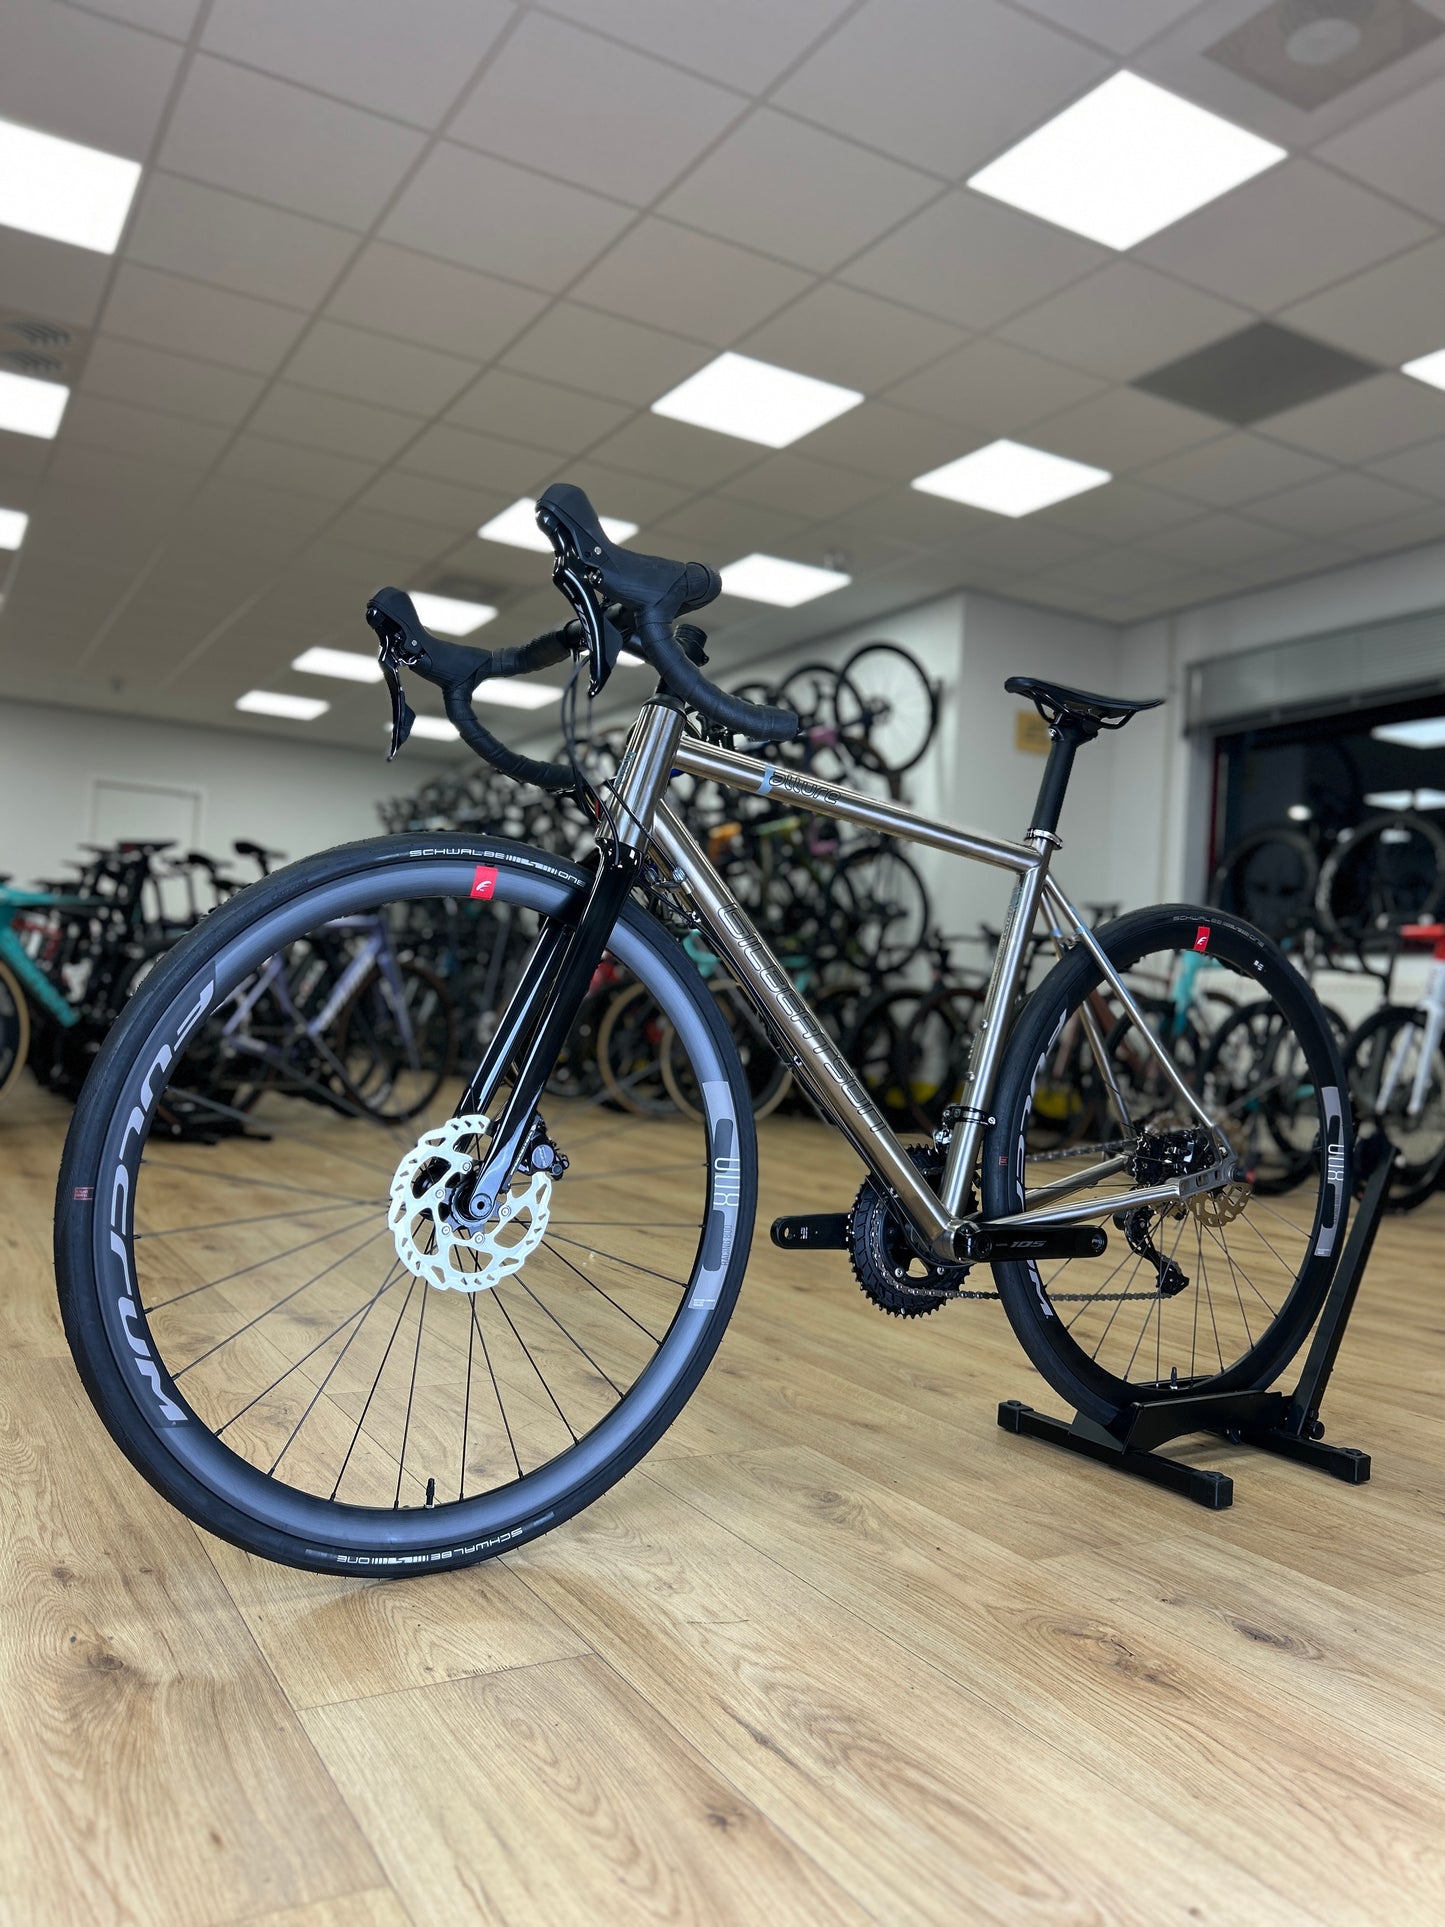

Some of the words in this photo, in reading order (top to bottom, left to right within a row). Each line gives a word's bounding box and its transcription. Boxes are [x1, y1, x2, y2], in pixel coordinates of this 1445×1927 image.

[409, 848, 505, 860] SCHWALBE
[557, 871, 587, 888] ONE
[109, 979, 215, 1422] FULCRUM
[1010, 1240, 1047, 1248] 105
[336, 1554, 371, 1565] ONE
[430, 1527, 523, 1560] SCHWALBE
